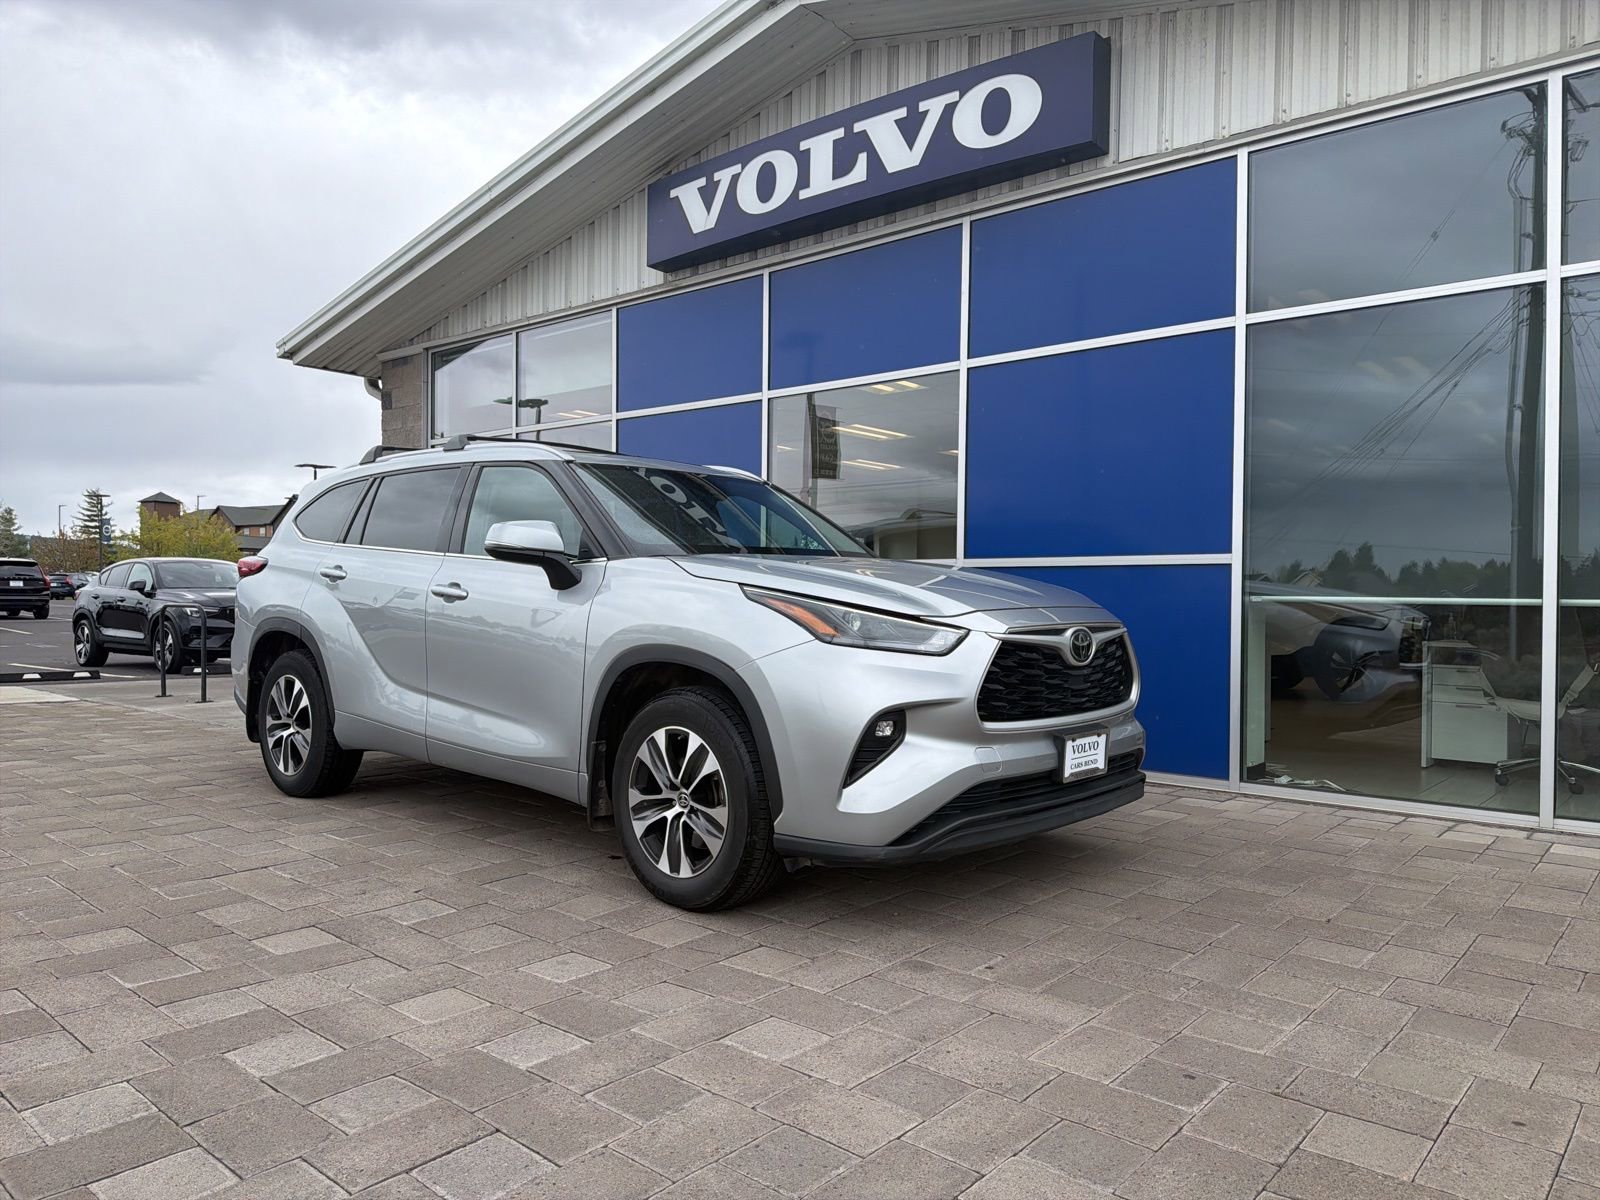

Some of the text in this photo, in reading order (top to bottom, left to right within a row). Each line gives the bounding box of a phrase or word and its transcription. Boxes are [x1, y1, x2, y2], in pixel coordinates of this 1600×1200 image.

[669, 73, 1043, 235] VOLVO
[1072, 740, 1099, 755] VOLVO
[1070, 758, 1098, 770] CARS BEND
